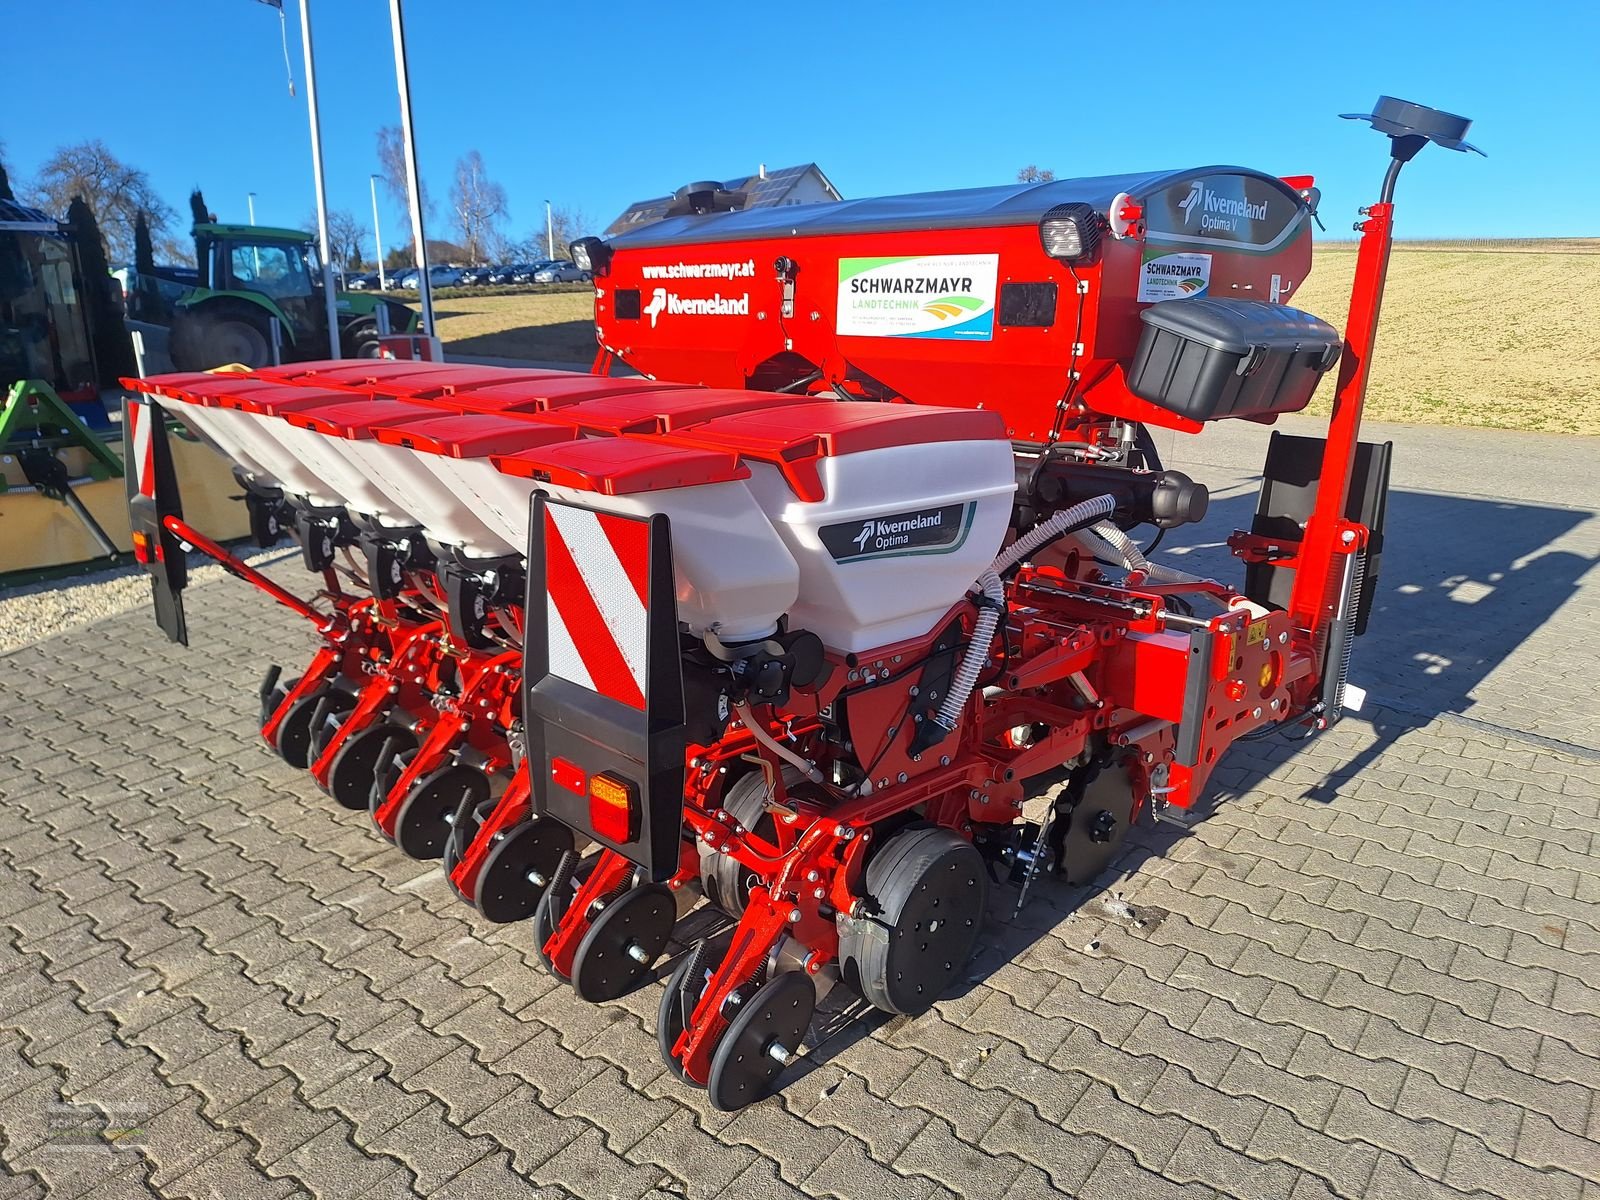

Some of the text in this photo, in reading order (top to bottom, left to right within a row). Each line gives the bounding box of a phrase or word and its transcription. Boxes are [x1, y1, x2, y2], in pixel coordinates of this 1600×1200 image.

[1204, 189, 1268, 220] Kverneland
[1201, 214, 1238, 231] Optima V
[642, 259, 755, 280] www.schwarzmayr.at
[1146, 263, 1202, 276] SCHWARZMAYR
[851, 277, 973, 294] SCHWARZMAYR
[667, 292, 749, 315] Kverneland
[852, 299, 919, 310] LANDTECHNIK
[876, 511, 942, 536] Kverneland
[875, 535, 909, 550] Optima
